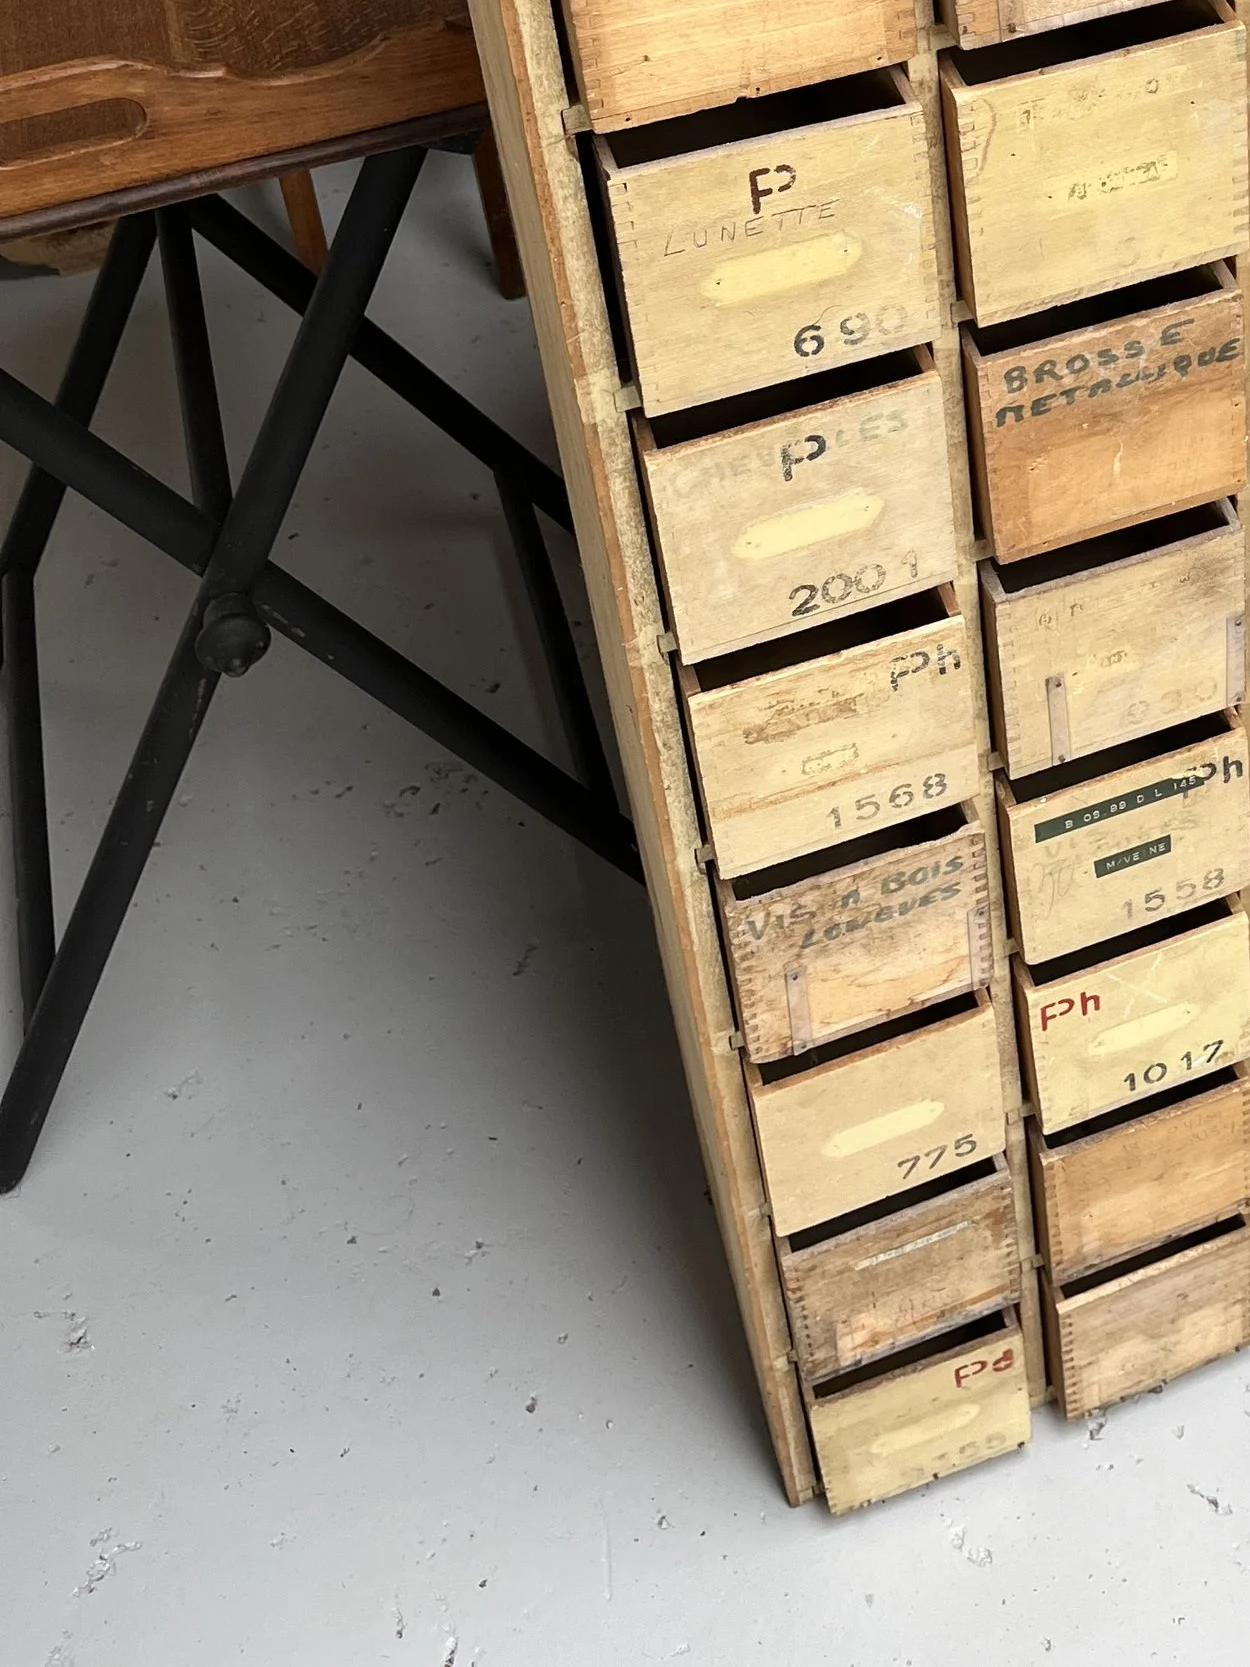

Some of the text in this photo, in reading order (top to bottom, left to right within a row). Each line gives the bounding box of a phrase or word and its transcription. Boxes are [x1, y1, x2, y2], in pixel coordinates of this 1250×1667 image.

[749, 163, 797, 215] P
[663, 198, 841, 258] LUNETTE
[793, 304, 909, 358] 690
[1003, 318, 1195, 395] BROSSE
[778, 434, 827, 483] P
[788, 549, 919, 617] 2001
[826, 772, 948, 829] 1568
[1154, 788, 1163, 798] L
[1173, 776, 1197, 791] 145
[880, 854, 964, 896] BOIS
[801, 881, 962, 950] LONGUES
[1040, 991, 1101, 1032] Ph
[1123, 1038, 1225, 1092] 1017
[896, 1133, 978, 1180] 775
